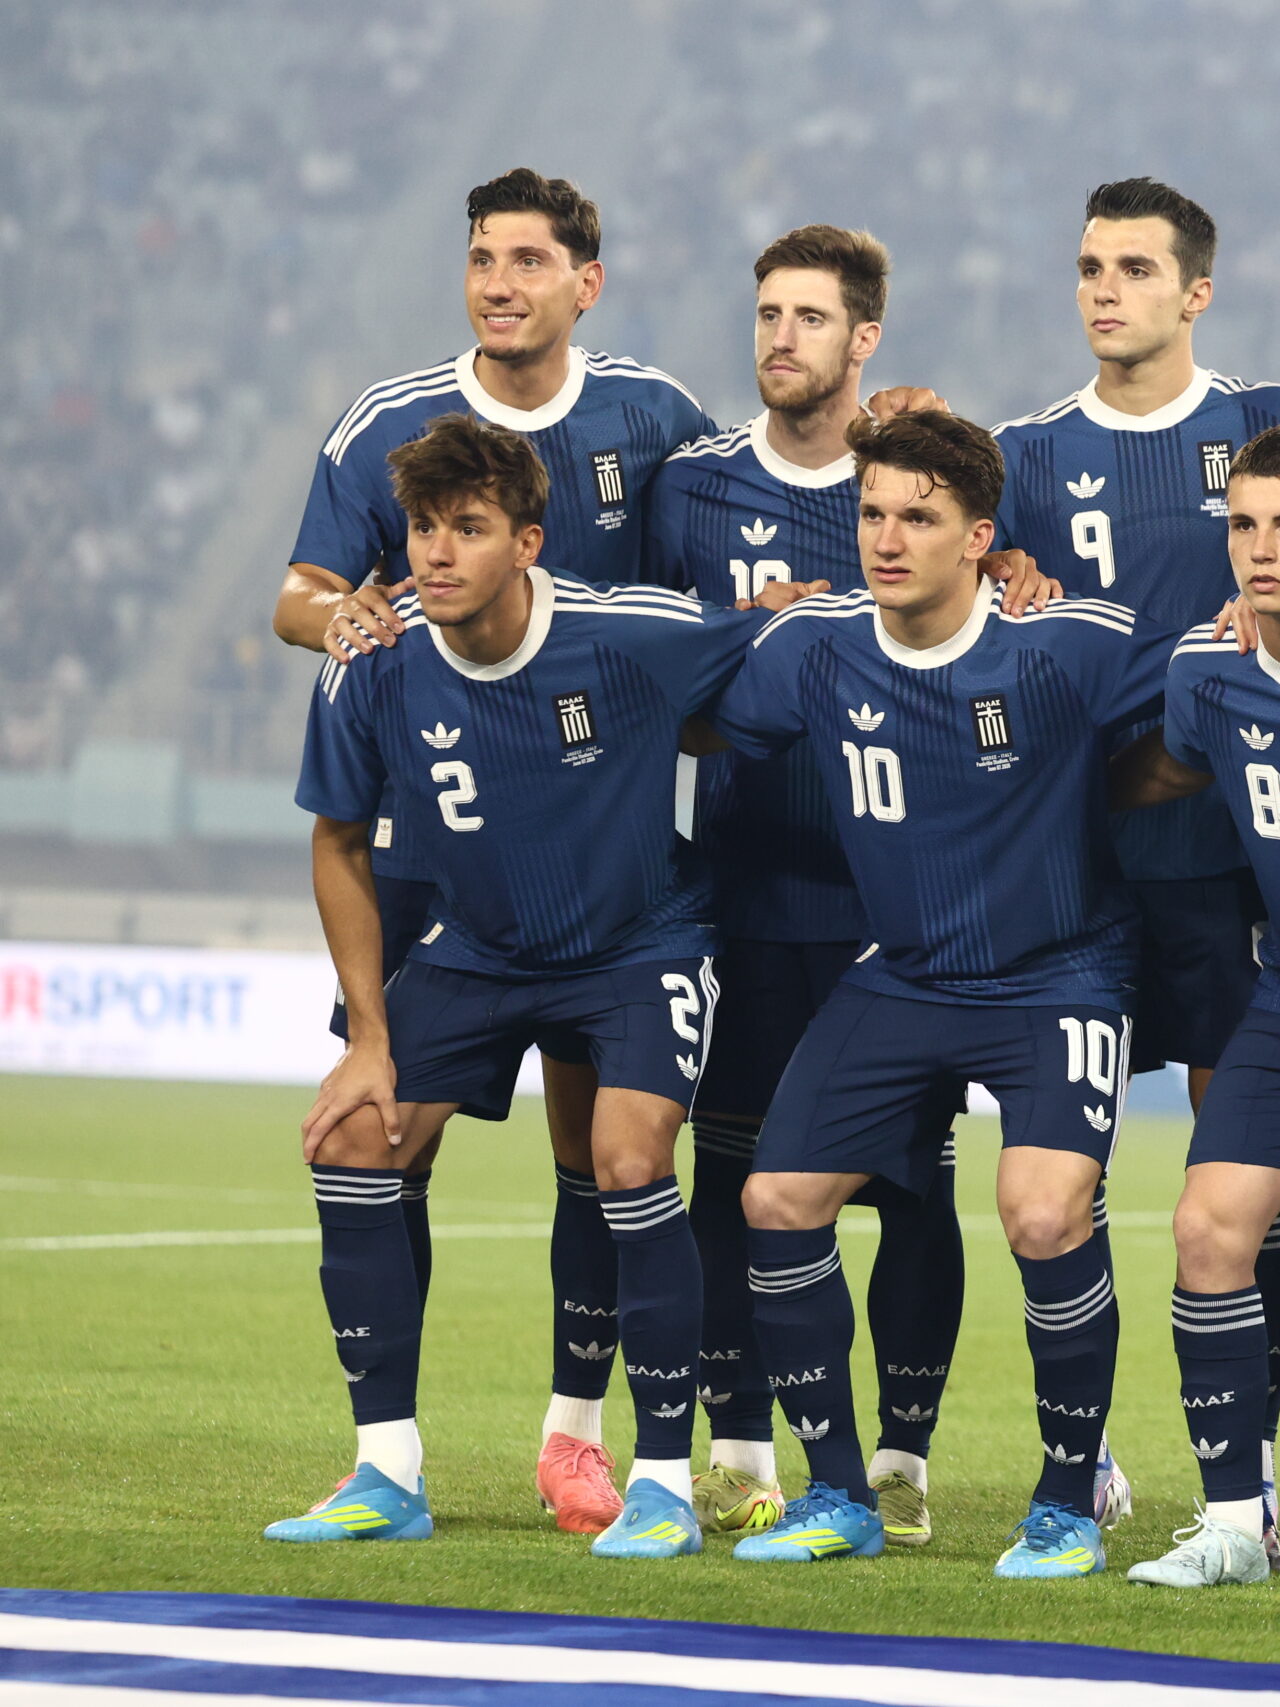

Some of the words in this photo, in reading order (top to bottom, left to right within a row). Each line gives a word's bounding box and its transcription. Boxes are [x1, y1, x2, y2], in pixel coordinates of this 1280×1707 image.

[1071, 510, 1116, 588] 9
[430, 760, 484, 832] 2
[842, 740, 906, 823] 10
[661, 973, 700, 1045] 2
[1059, 1017, 1117, 1097] 10
[626, 1365, 690, 1380] ΕΛΛΑΣ
